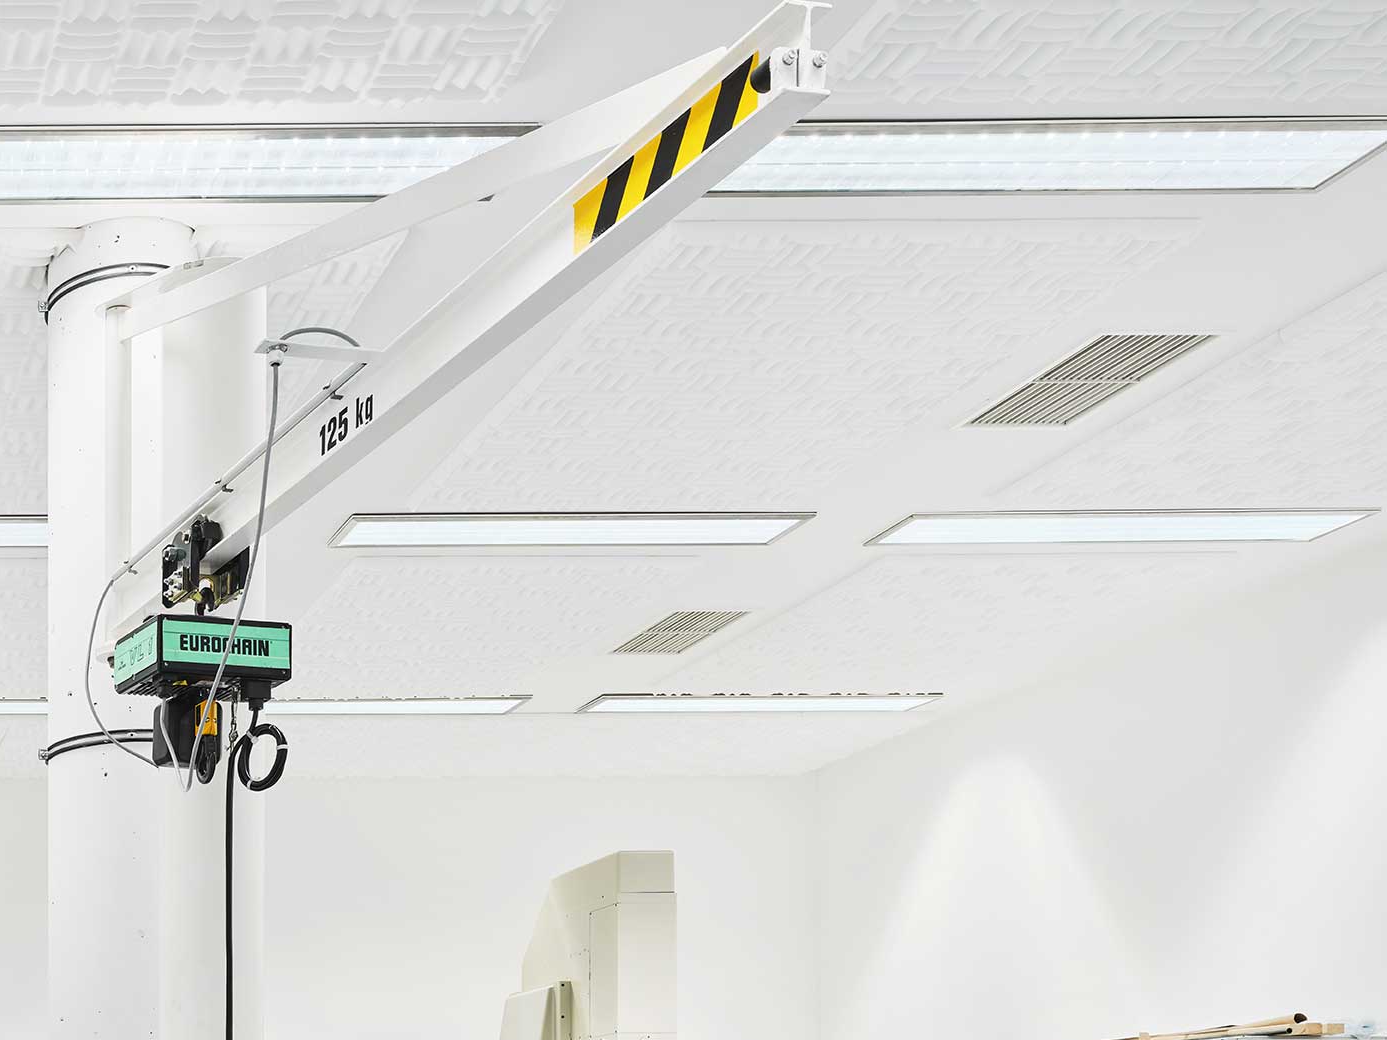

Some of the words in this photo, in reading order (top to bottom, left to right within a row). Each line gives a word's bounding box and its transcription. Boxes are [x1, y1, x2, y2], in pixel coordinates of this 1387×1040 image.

[319, 406, 349, 456] 125
[355, 394, 374, 430] kg
[179, 634, 270, 657] EUROCHAIN
